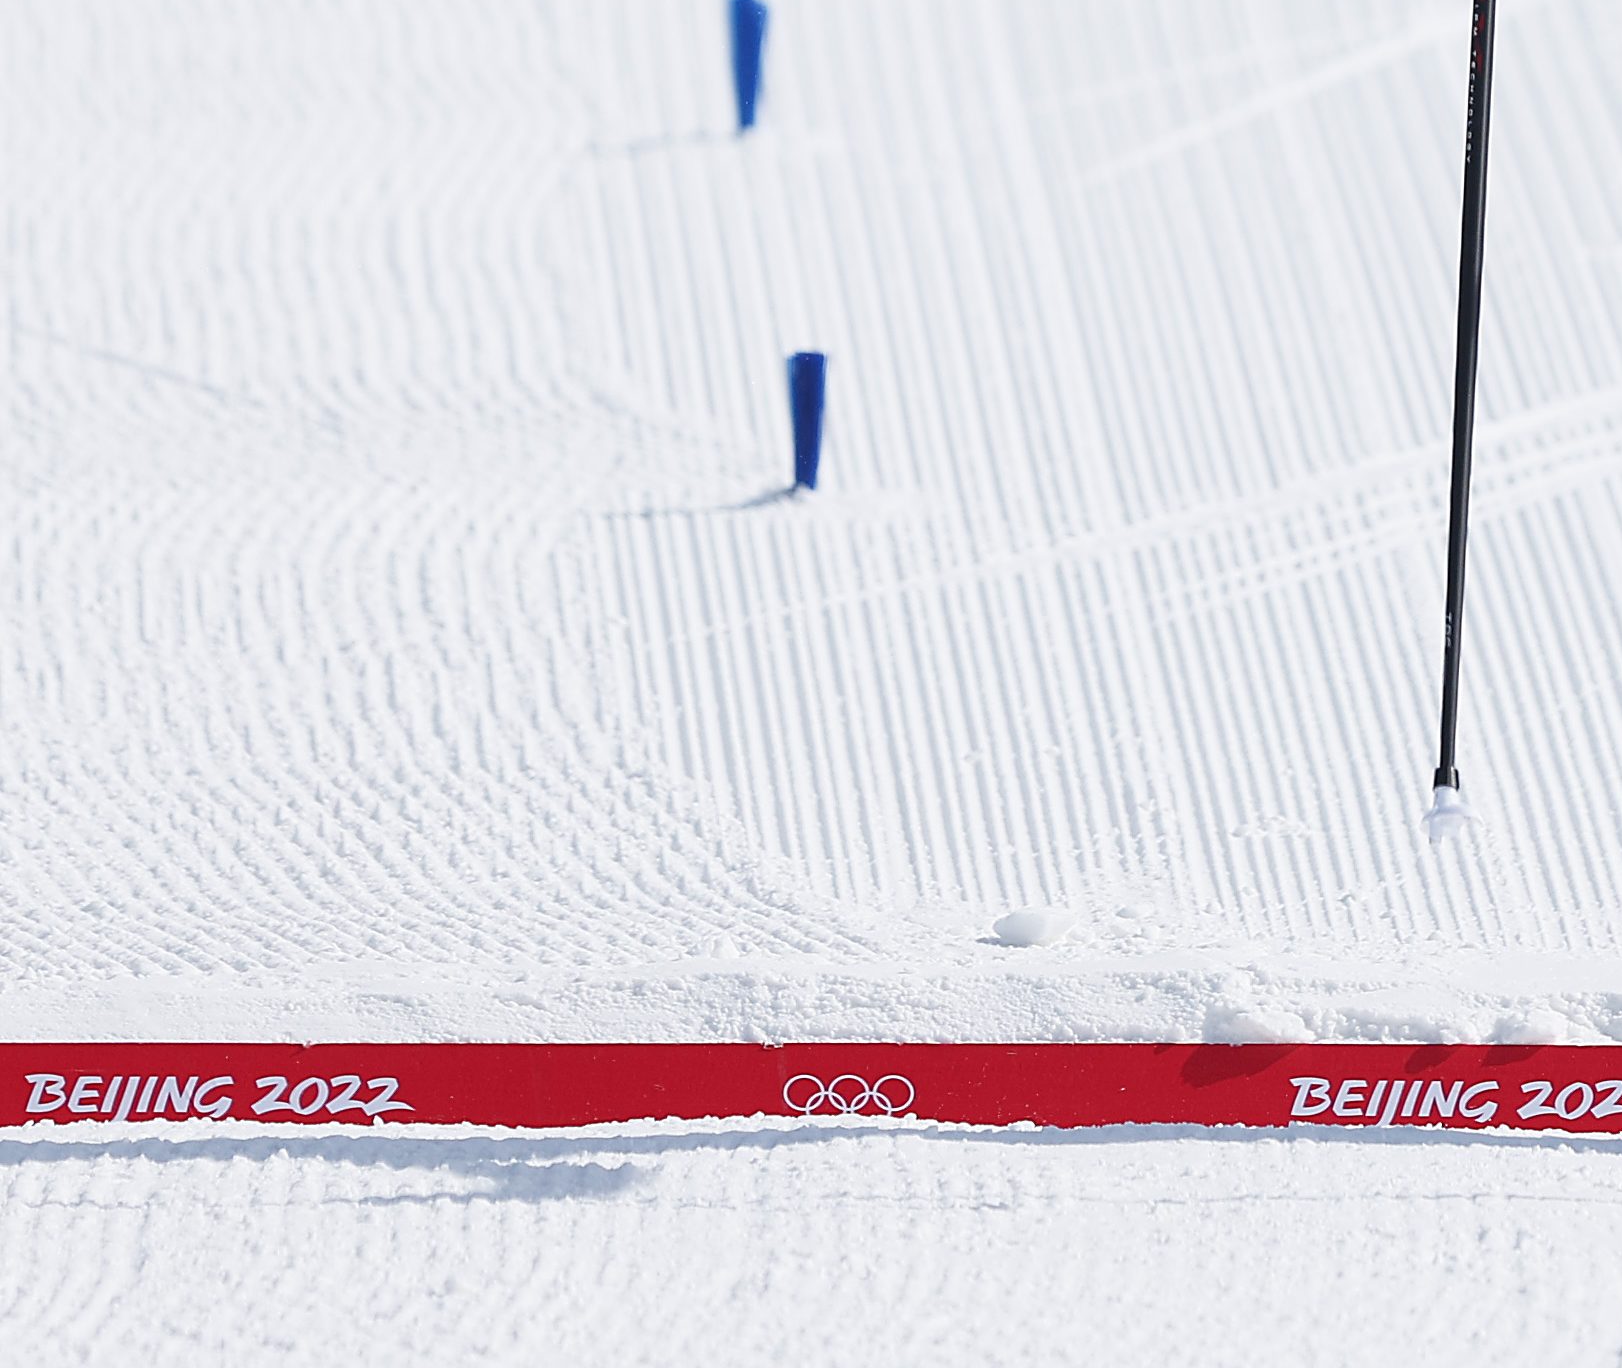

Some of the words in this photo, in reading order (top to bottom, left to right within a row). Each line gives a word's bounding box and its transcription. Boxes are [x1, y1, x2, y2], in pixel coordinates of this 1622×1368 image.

[25, 1074, 234, 1119] BEIJING
[251, 1075, 415, 1115] 2022
[1290, 1077, 1500, 1126] BEIJING
